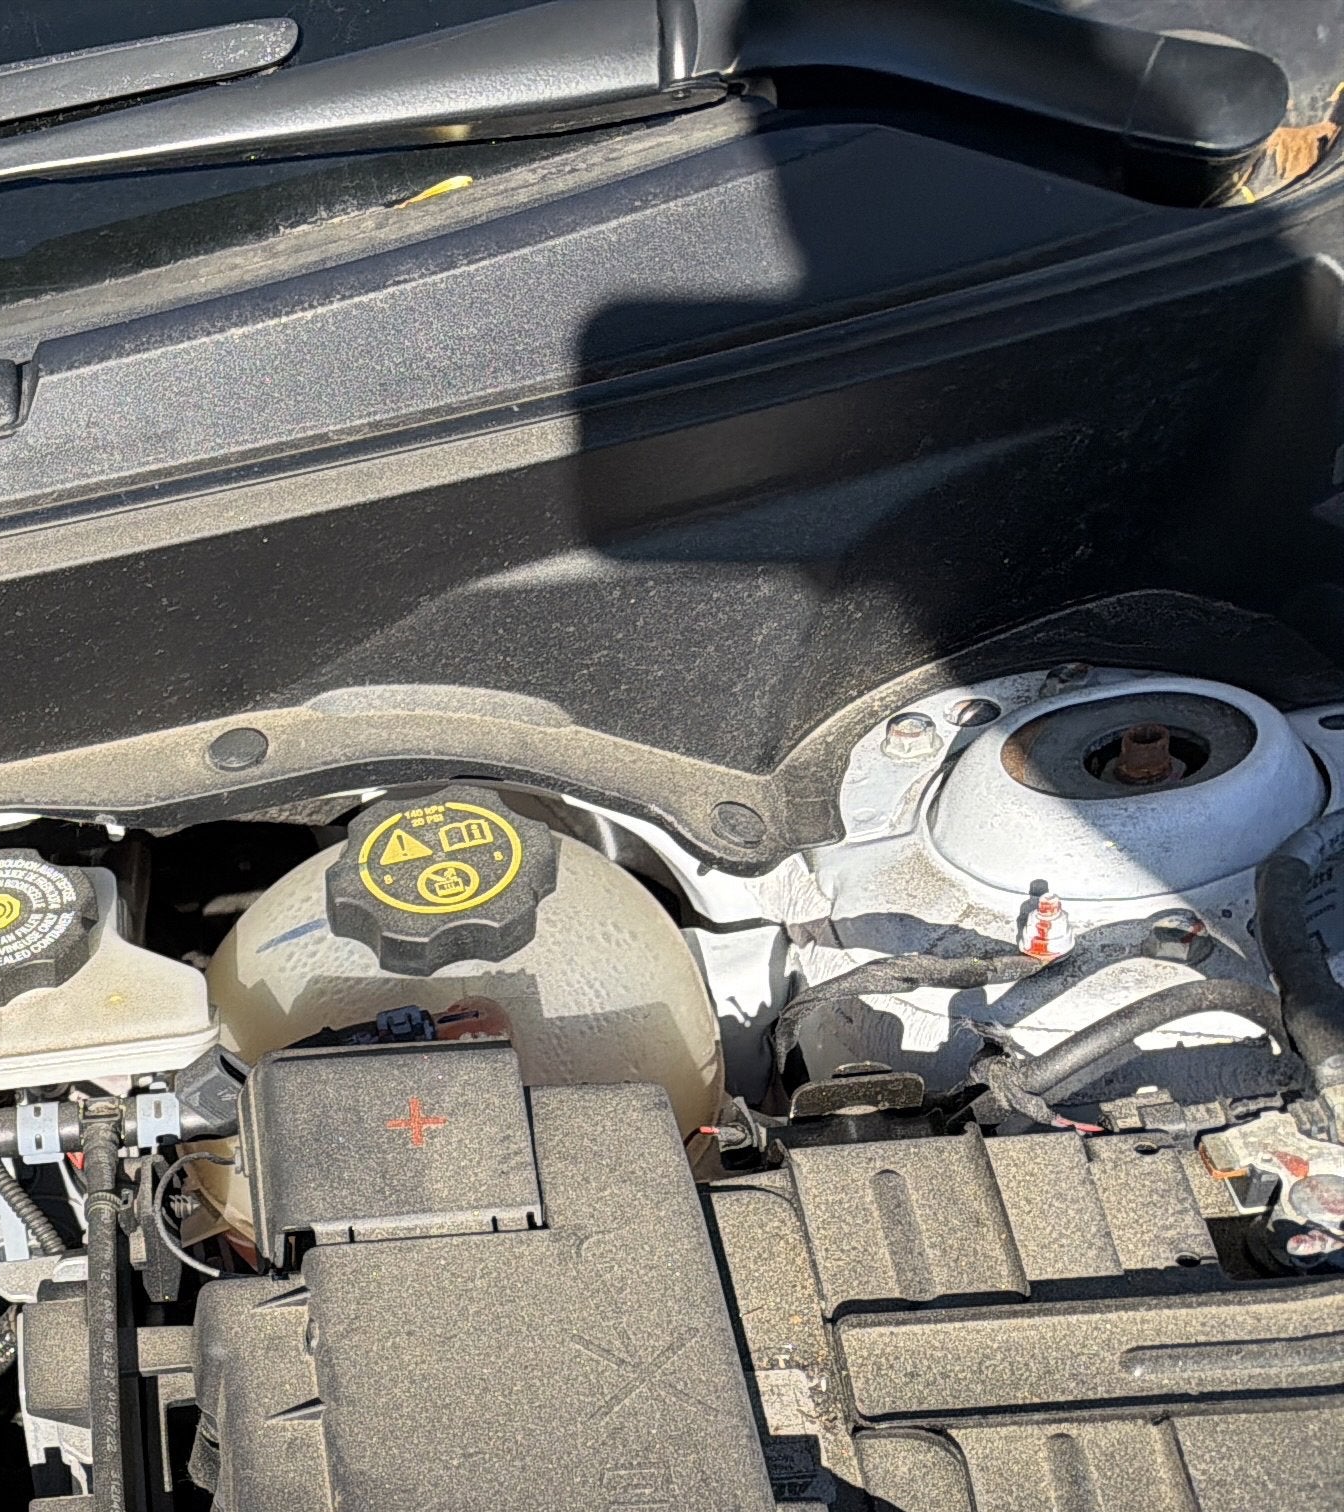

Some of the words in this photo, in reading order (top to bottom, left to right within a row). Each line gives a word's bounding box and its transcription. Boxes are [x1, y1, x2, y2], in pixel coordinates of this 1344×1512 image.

[404, 808, 424, 819] 140
[411, 818, 427, 828] 20
[427, 814, 445, 825] PSI
[23, 871, 39, 882] DE
[14, 913, 43, 938] FILLER
[20, 929, 44, 946] USE
[35, 912, 59, 933] ONLY
